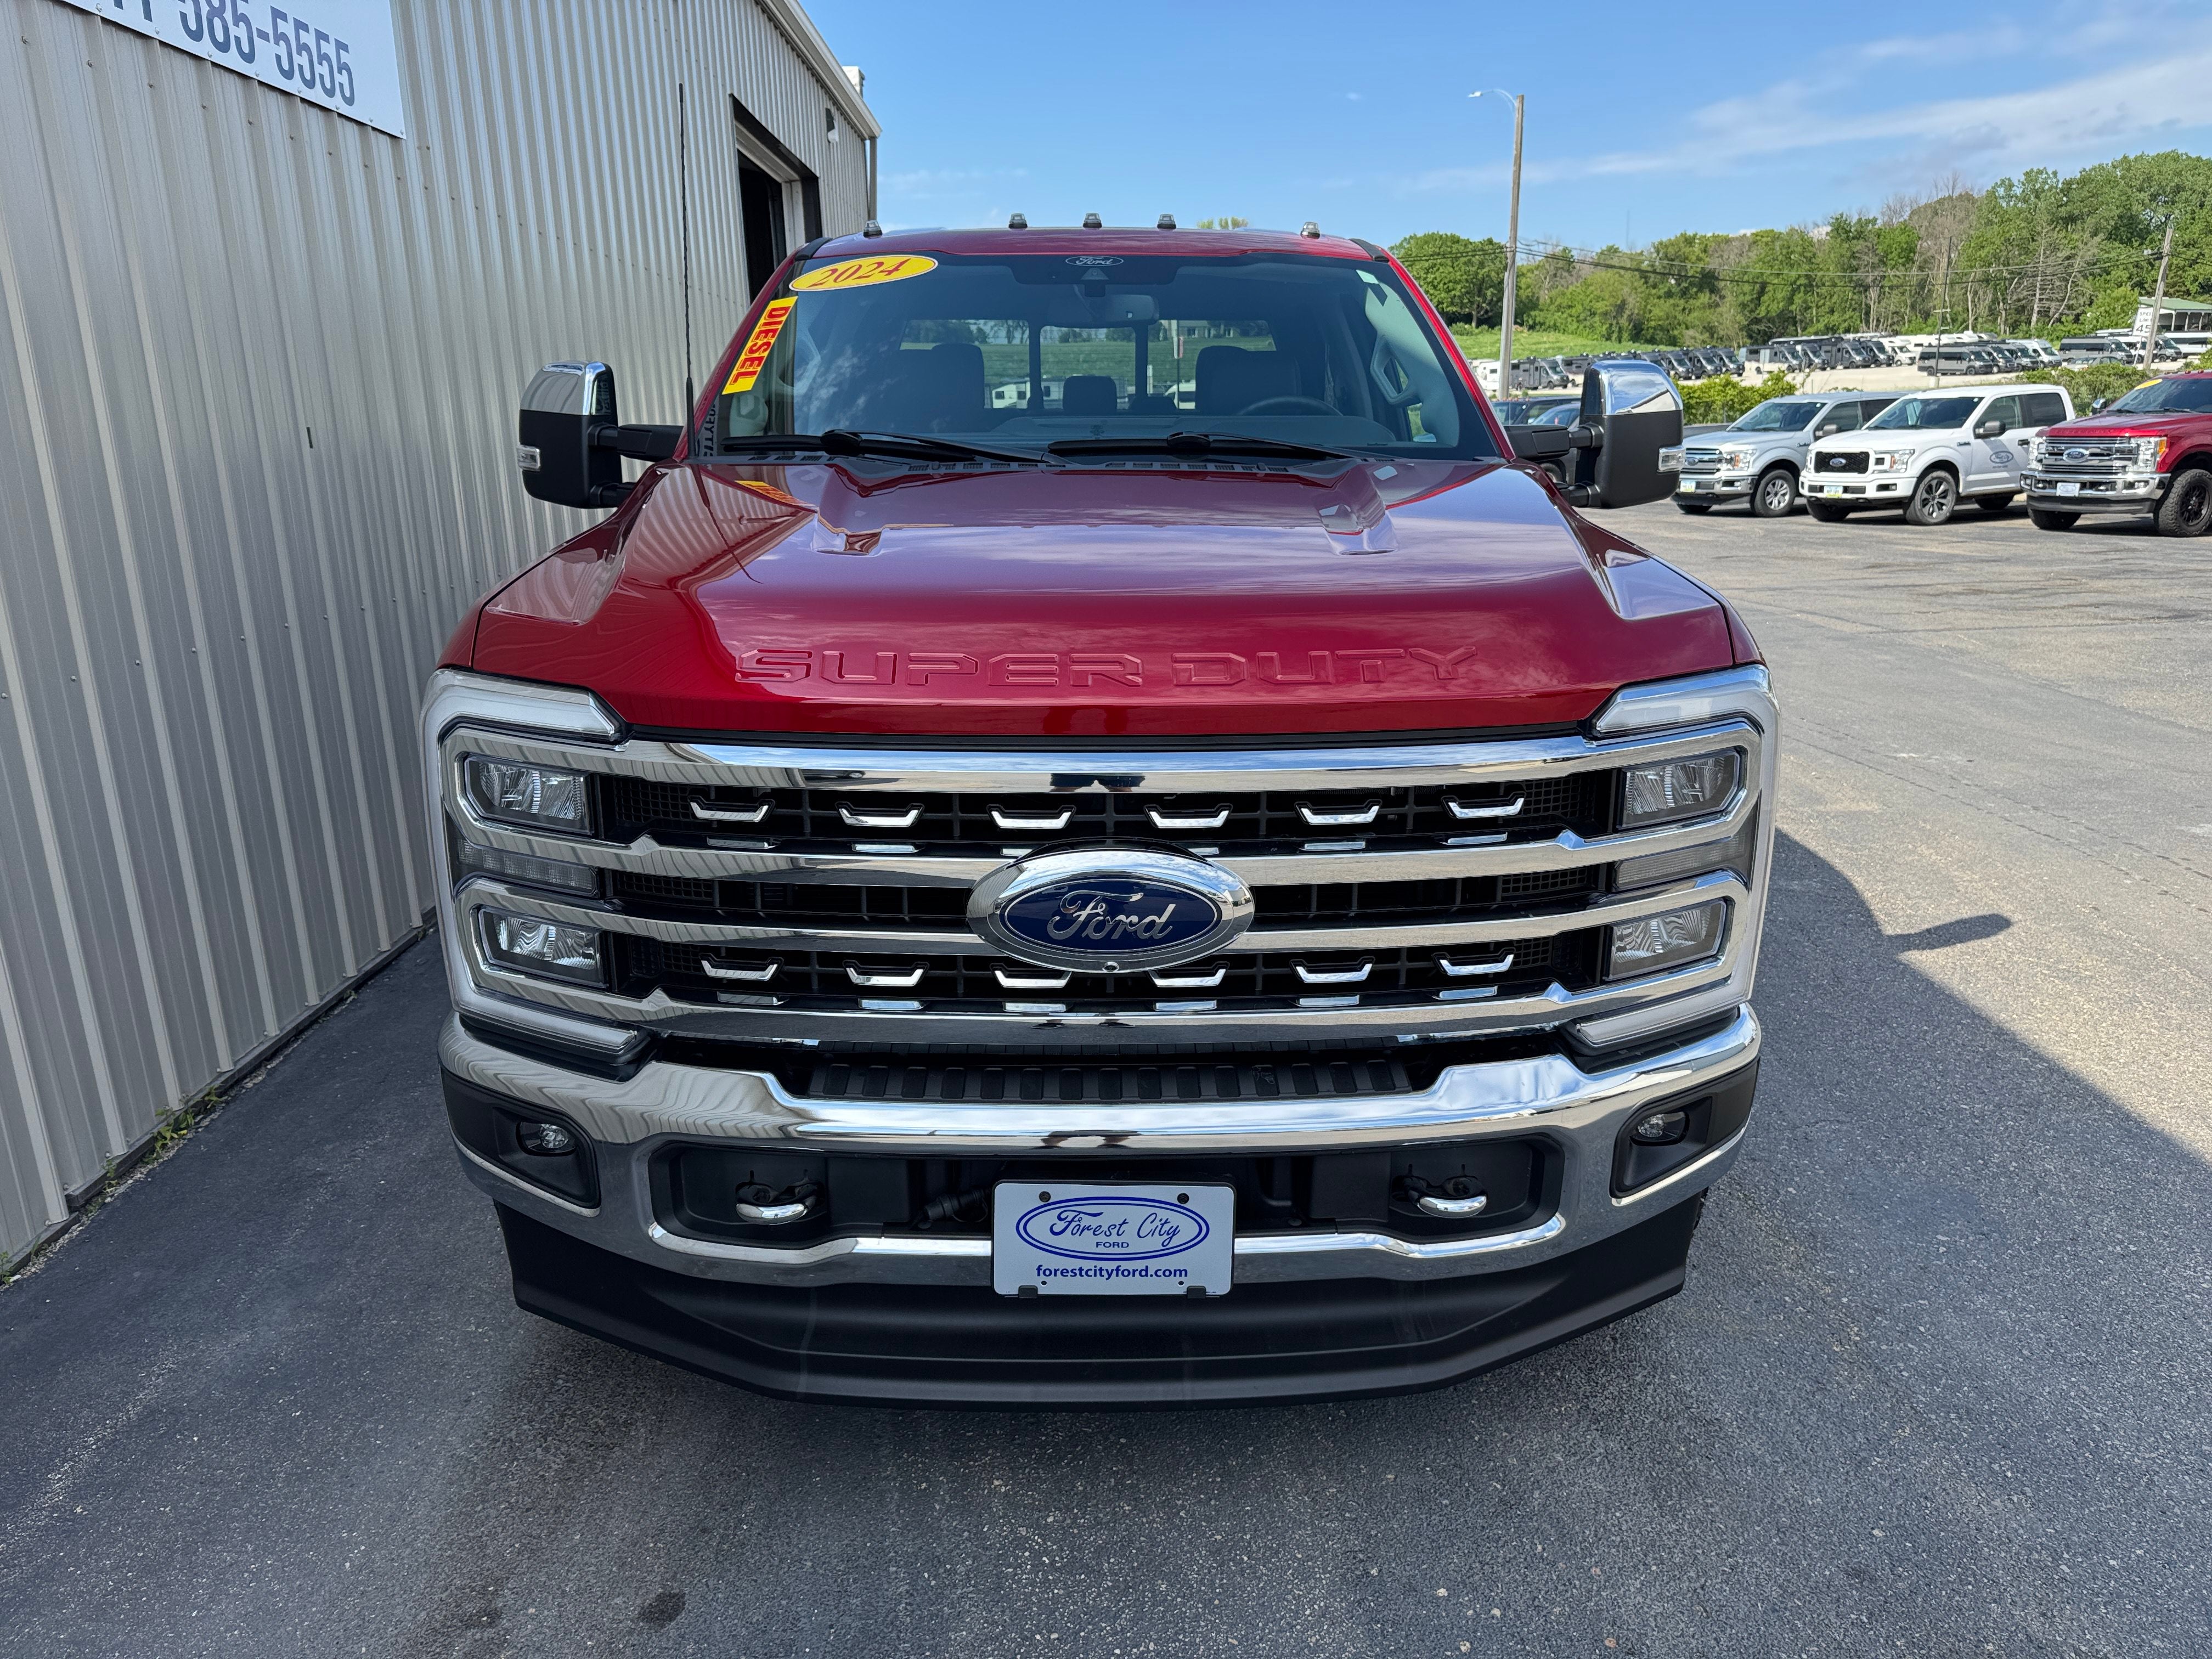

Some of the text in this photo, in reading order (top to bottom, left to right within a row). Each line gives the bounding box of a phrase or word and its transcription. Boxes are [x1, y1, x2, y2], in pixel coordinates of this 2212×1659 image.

[806, 258, 912, 288] 2024
[729, 306, 792, 386] DIESEL
[2136, 324, 2151, 333] 45
[735, 646, 1478, 687] SUPER DUTY
[1047, 890, 1176, 940] Ford
[1049, 1209, 1181, 1248] Forest City
[1036, 1264, 1188, 1280] forestcityford.com
